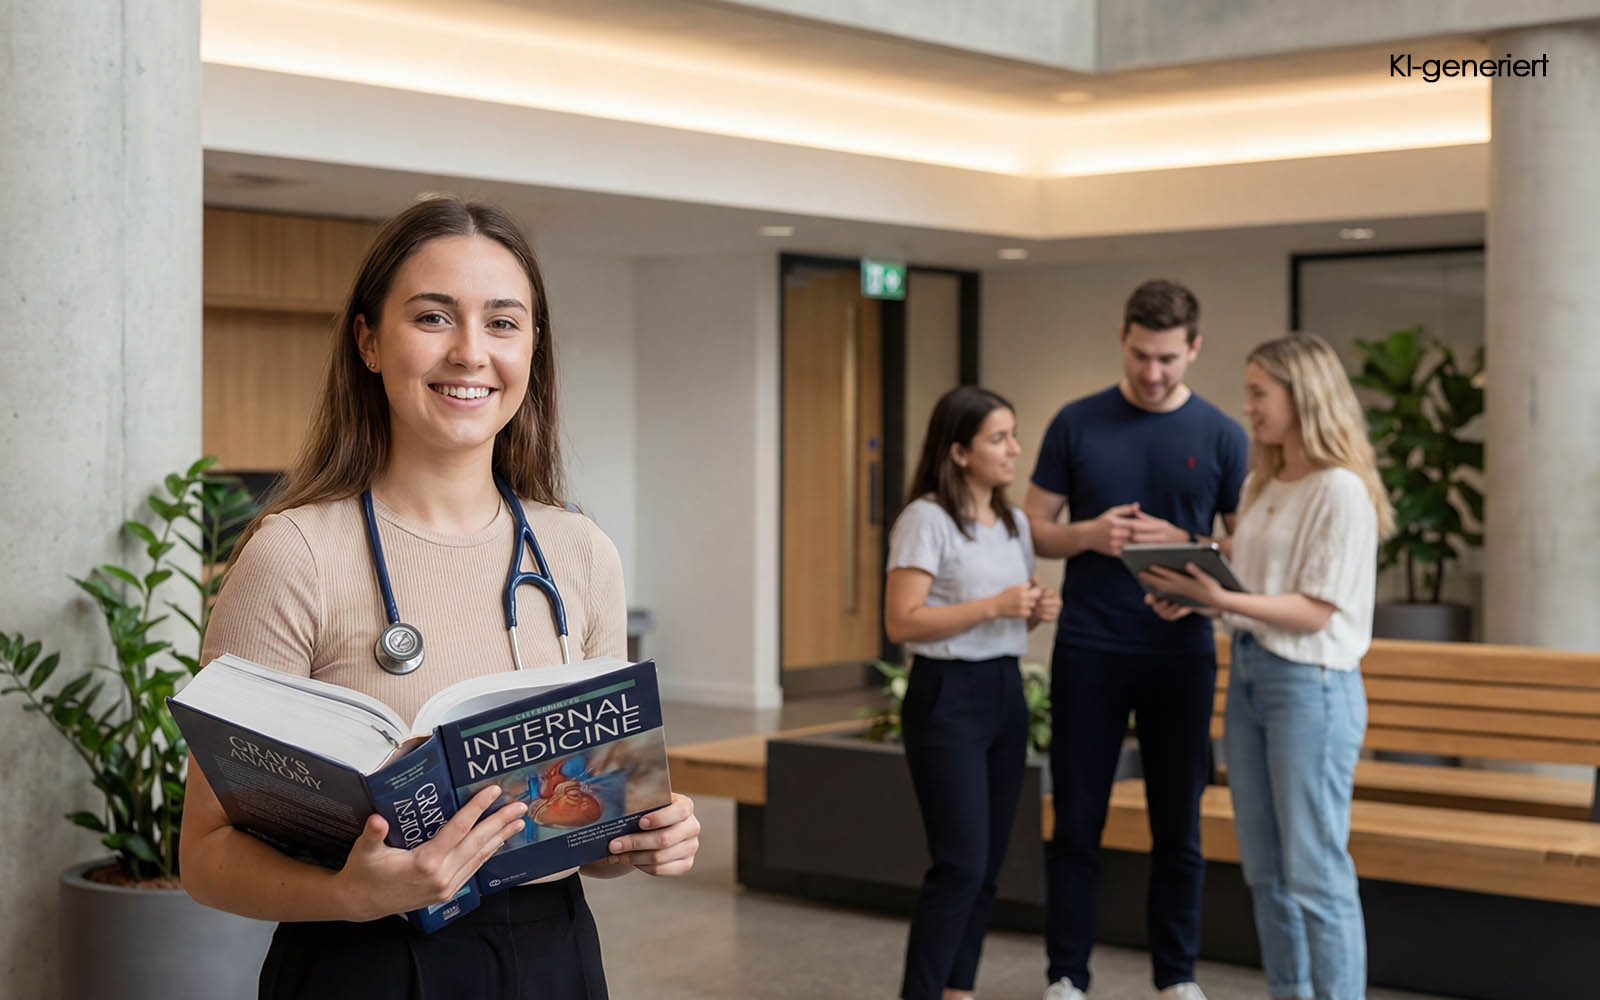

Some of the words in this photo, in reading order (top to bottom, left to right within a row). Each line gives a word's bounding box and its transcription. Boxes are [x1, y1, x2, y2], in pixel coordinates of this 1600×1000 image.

[463, 693, 639, 759] INTERNAL
[467, 711, 642, 779] MEDICINE
[229, 736, 310, 775] GRAY'S
[231, 748, 321, 790] ANATOMY
